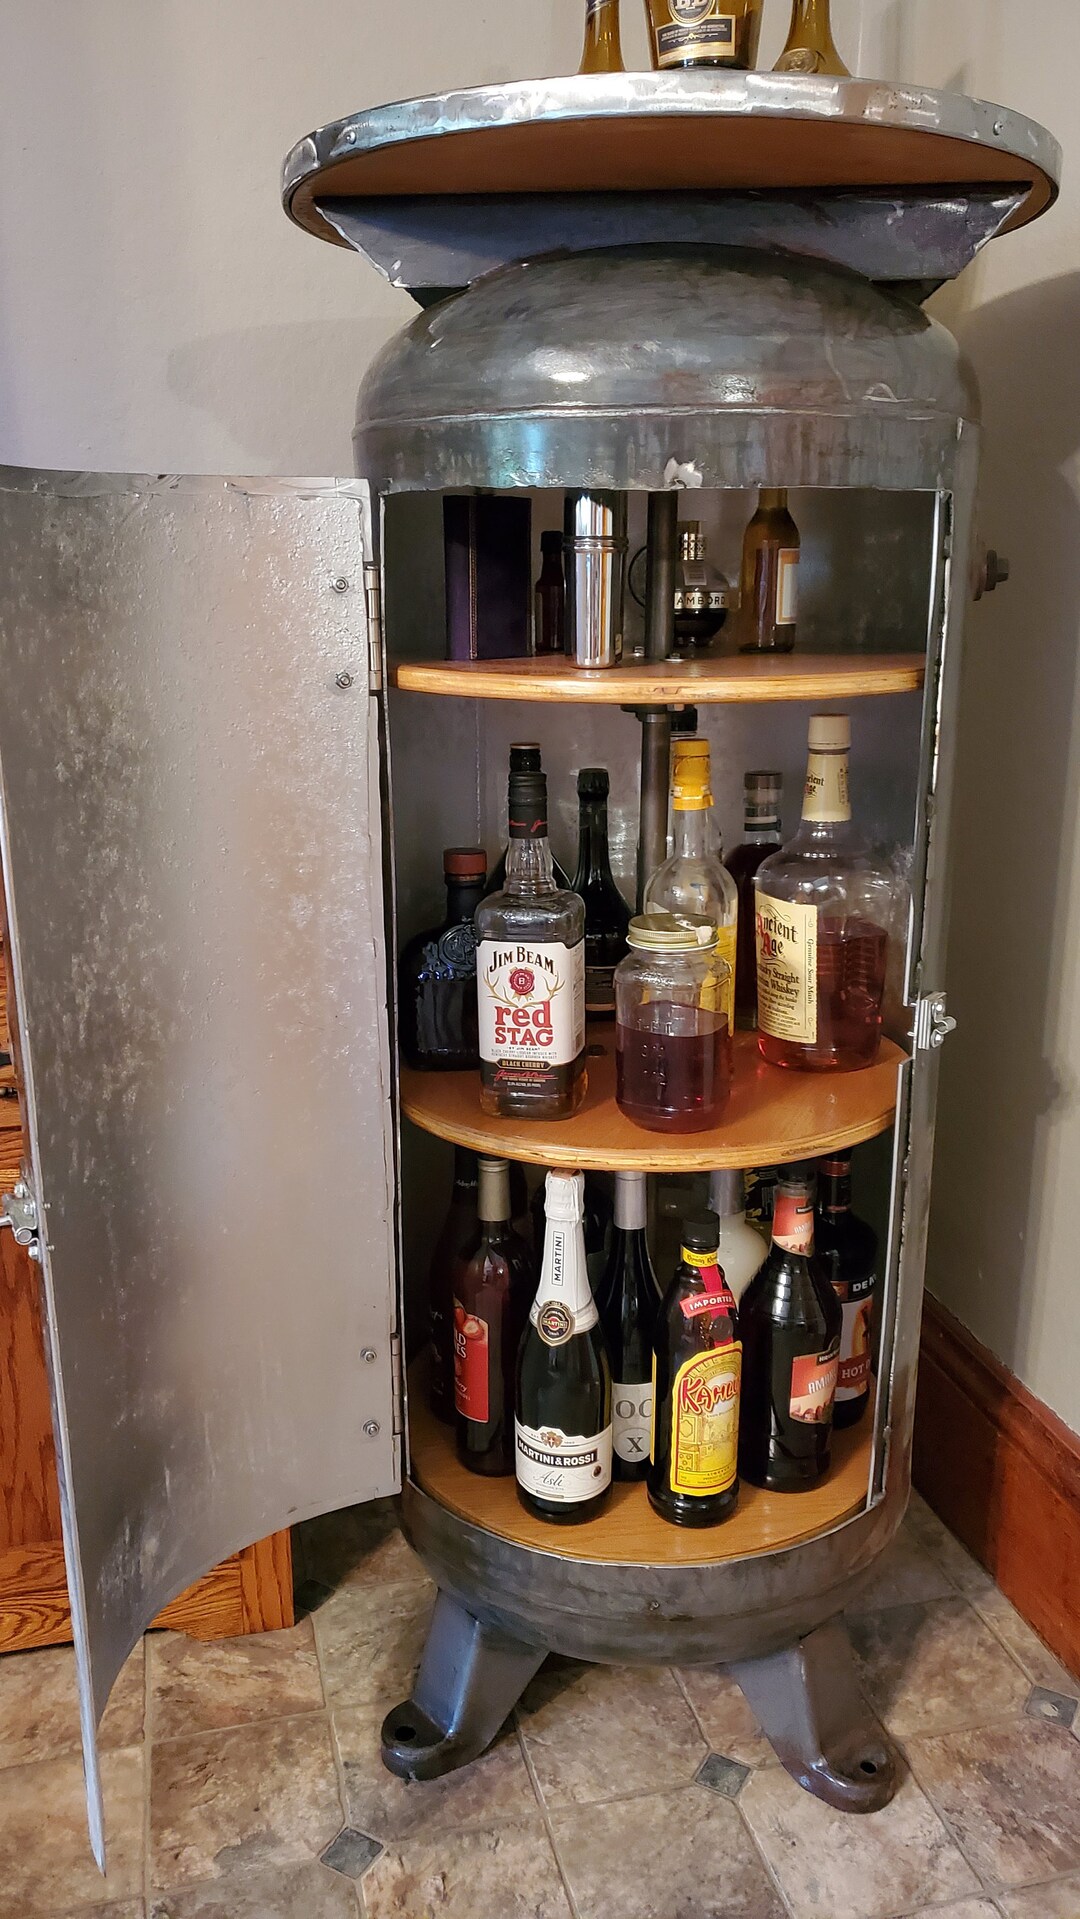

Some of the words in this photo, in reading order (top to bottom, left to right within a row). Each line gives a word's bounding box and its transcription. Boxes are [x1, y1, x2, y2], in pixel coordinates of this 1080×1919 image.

[676, 596, 725, 606] AMBORD
[761, 932, 784, 957] Age
[489, 950, 513, 972] JIM
[516, 946, 555, 975] BEAM
[772, 967, 800, 985] Straight
[807, 968, 815, 983] Sour
[770, 978, 800, 998] Whiskey
[807, 985, 815, 1005] Mash
[494, 1000, 553, 1028] red
[494, 1026, 554, 1047] STAG
[521, 1060, 545, 1068] CHERRY
[554, 1236, 563, 1282] MARTINI
[841, 1363, 865, 1379] HOT
[519, 1440, 595, 1467] MARTINI&ROSSI
[626, 1437, 644, 1453] X
